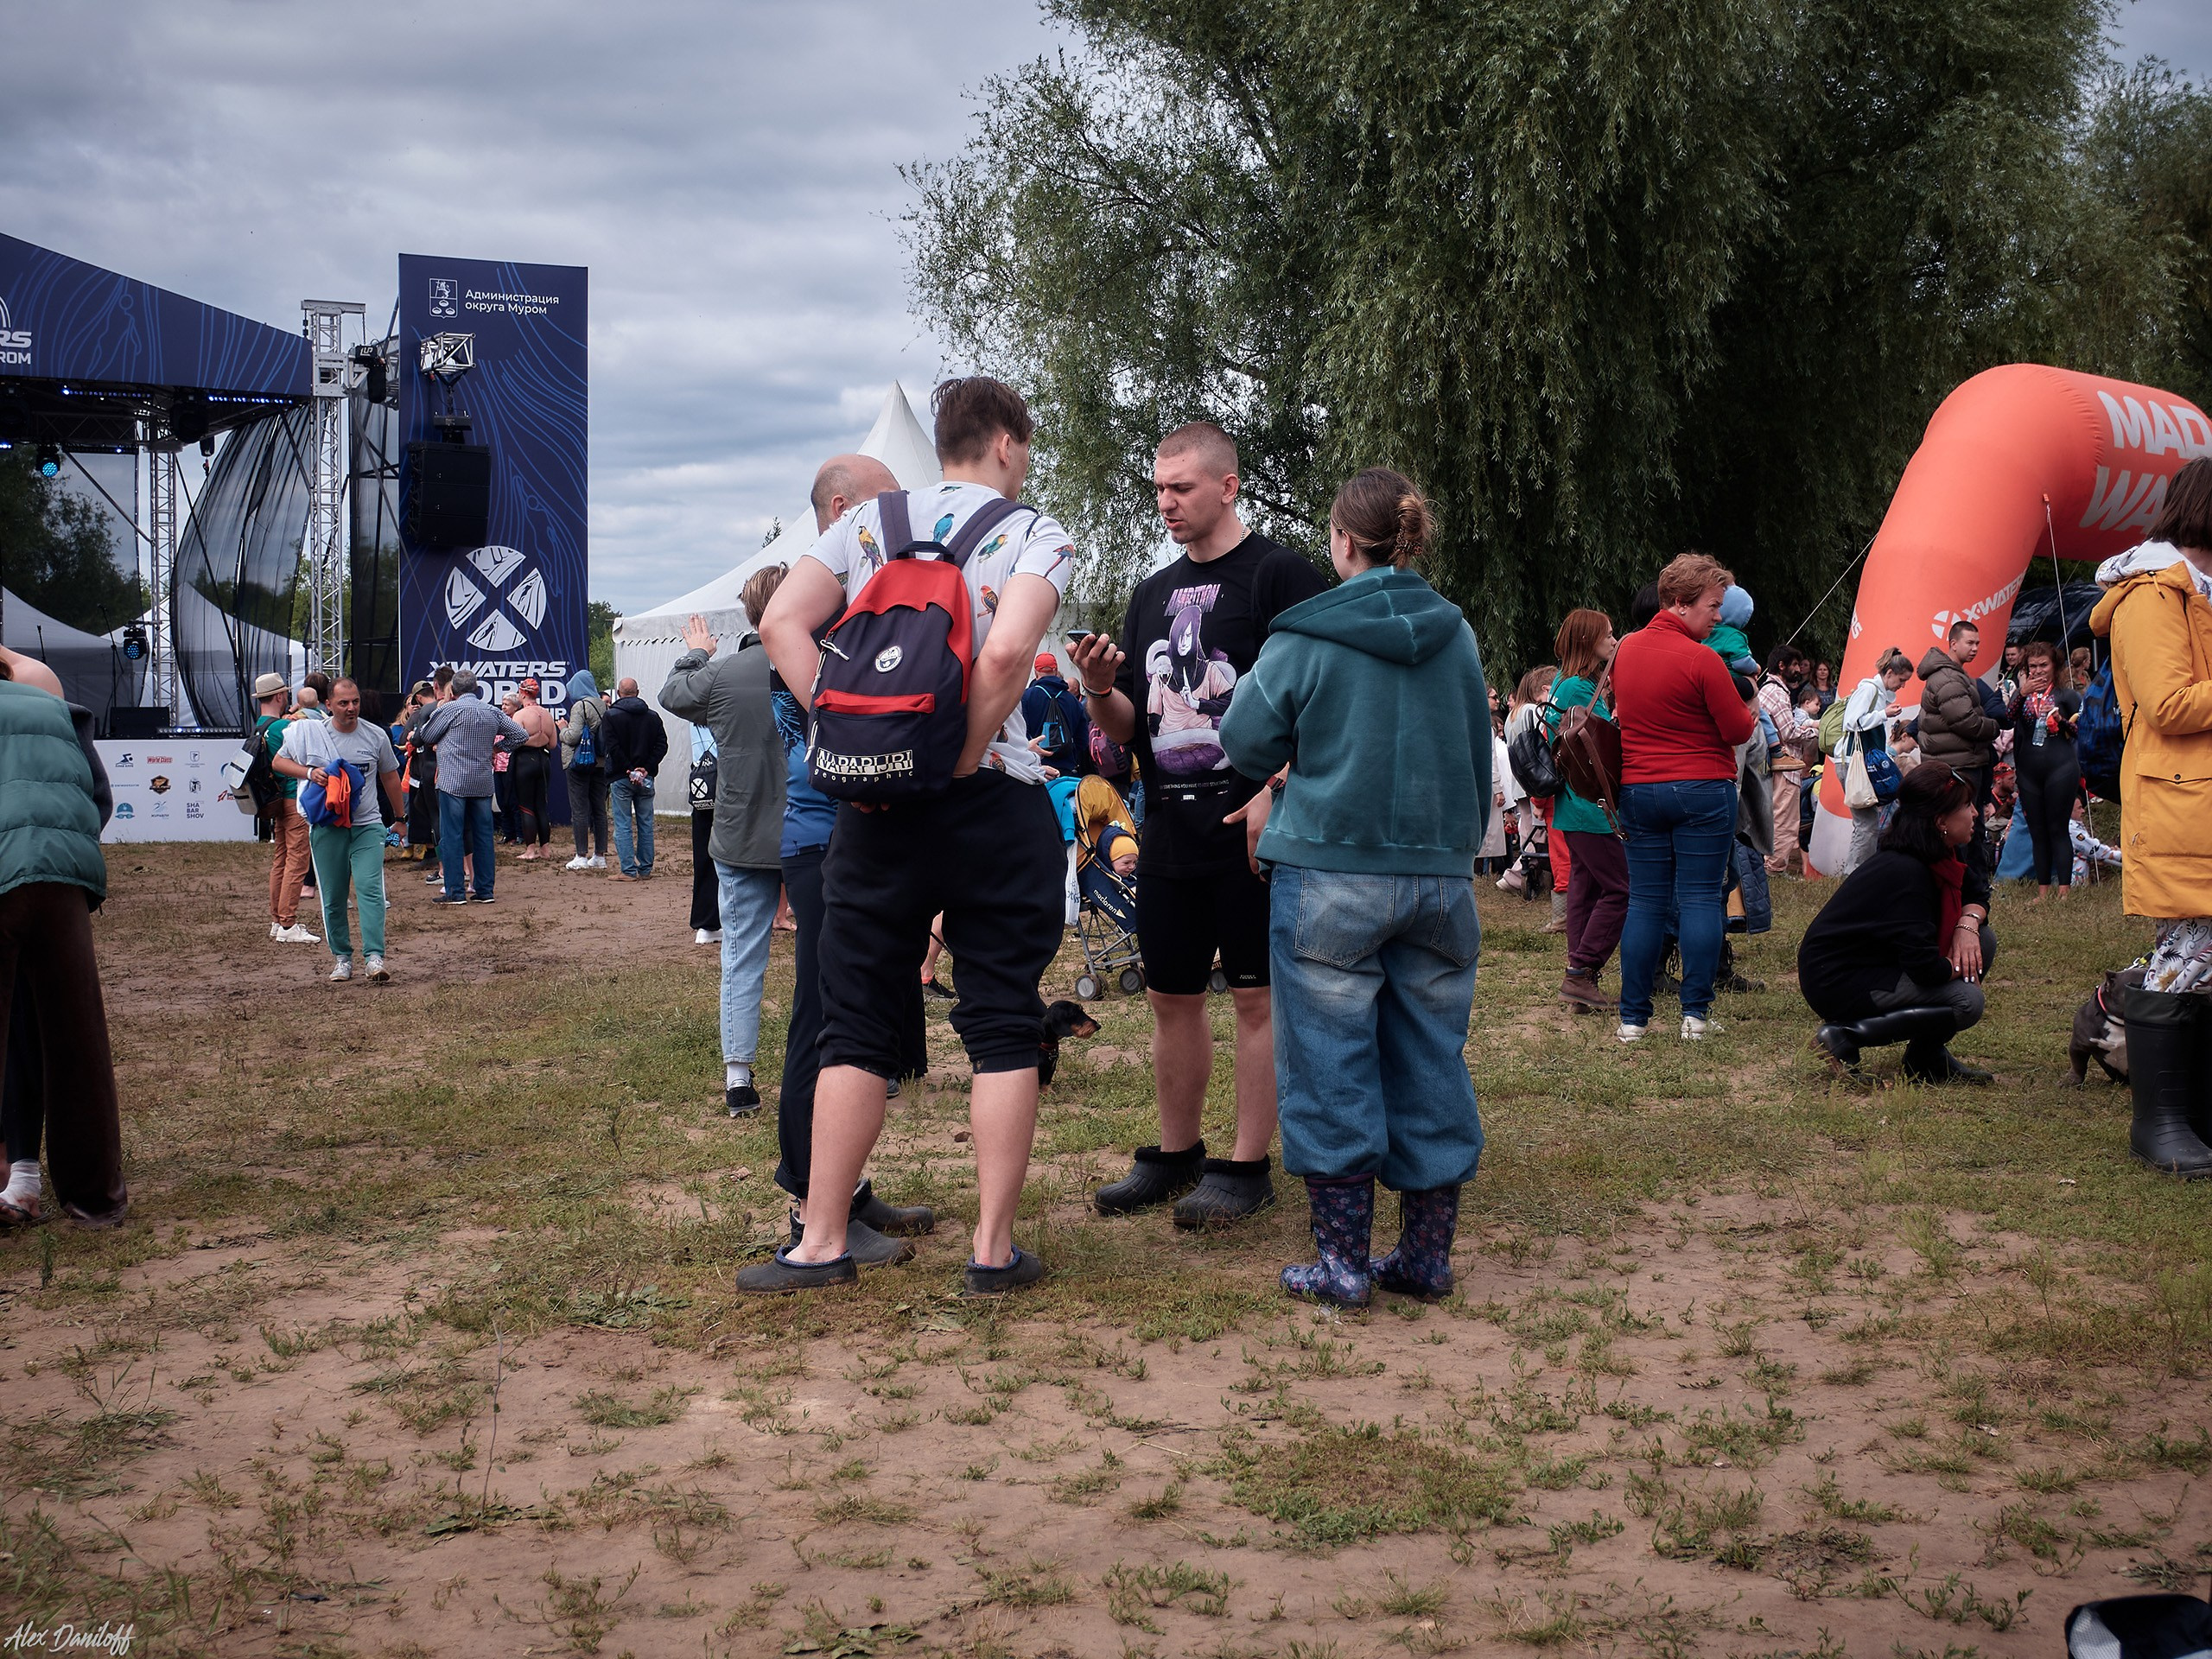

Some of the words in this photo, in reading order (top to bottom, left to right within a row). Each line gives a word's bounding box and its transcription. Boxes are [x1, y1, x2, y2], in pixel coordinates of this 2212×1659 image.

[465, 289, 559, 305] Администрация
[465, 302, 505, 313] округа
[508, 304, 547, 315] Муром
[2097, 391, 2212, 460] MAD
[429, 680, 567, 705] ORD
[816, 748, 913, 774] NAPAPIJRI
[814, 768, 913, 783] geographic
[1094, 889, 1118, 914] maclaren
